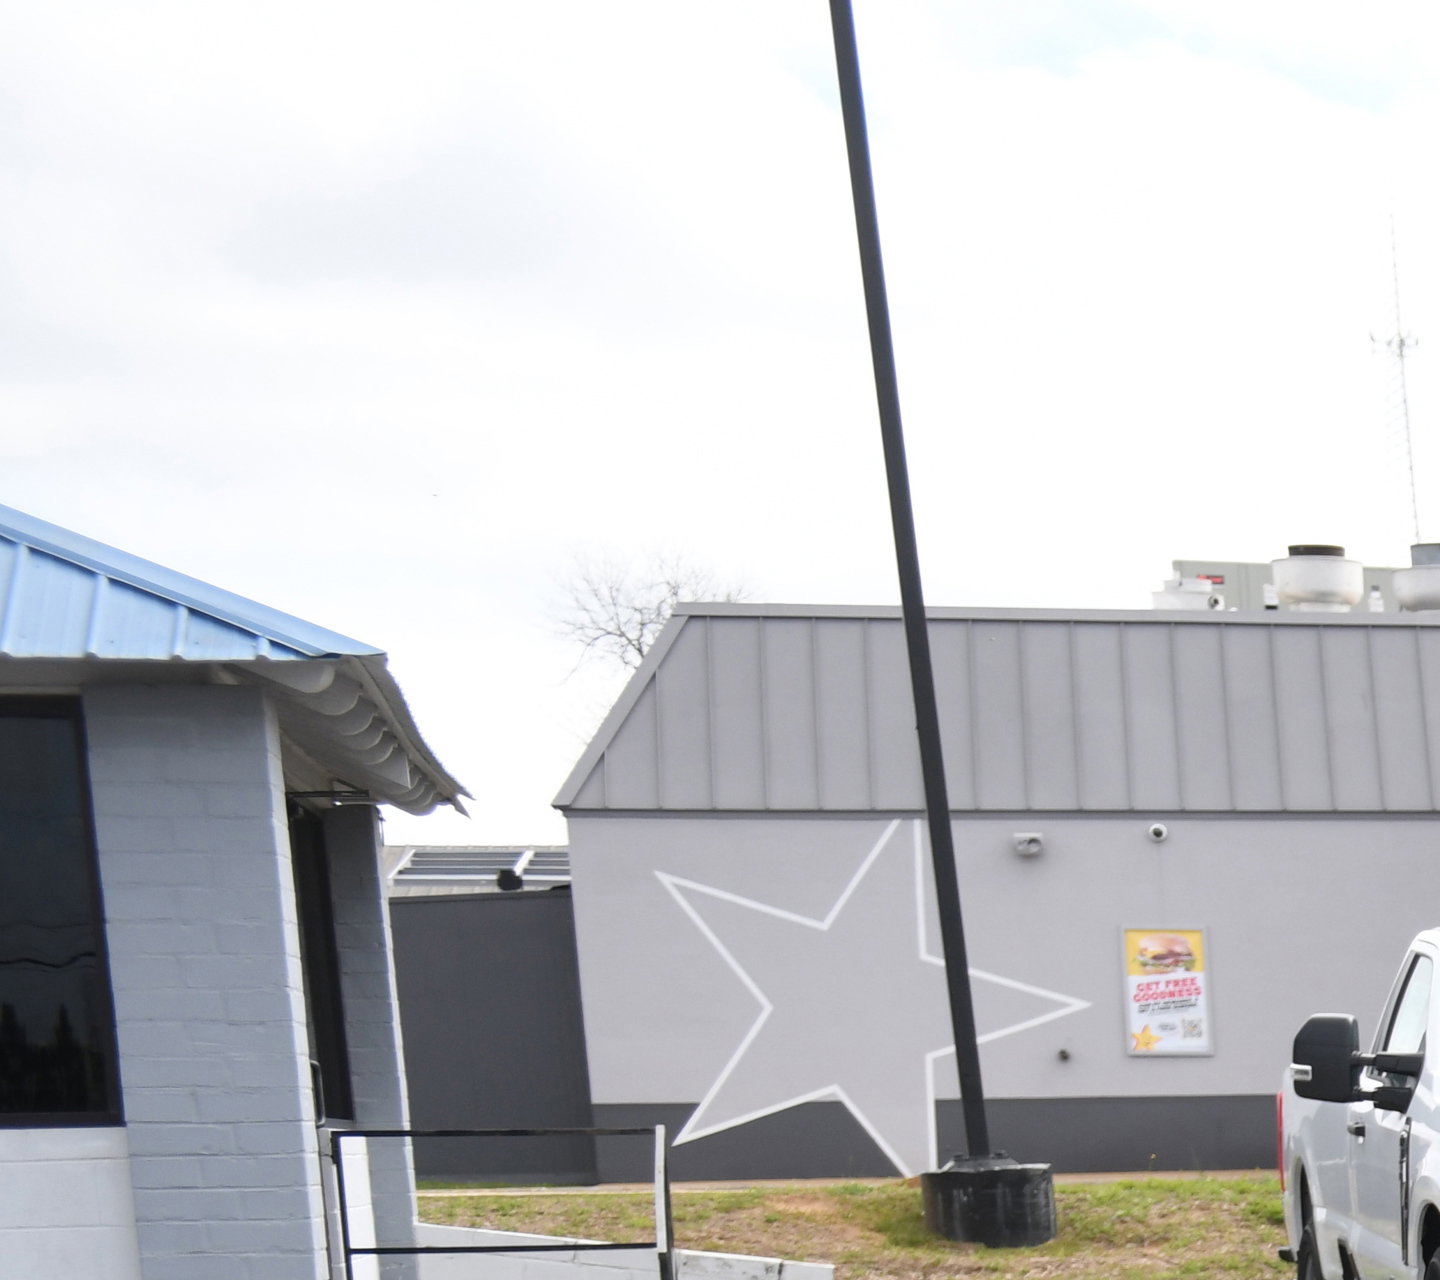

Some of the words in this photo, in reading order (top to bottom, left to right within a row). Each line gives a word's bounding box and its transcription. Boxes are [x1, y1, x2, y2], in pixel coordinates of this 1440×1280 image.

[1136, 981, 1160, 993] GET
[1165, 977, 1197, 989] FREE
[1133, 986, 1202, 1003] GOODNESS
